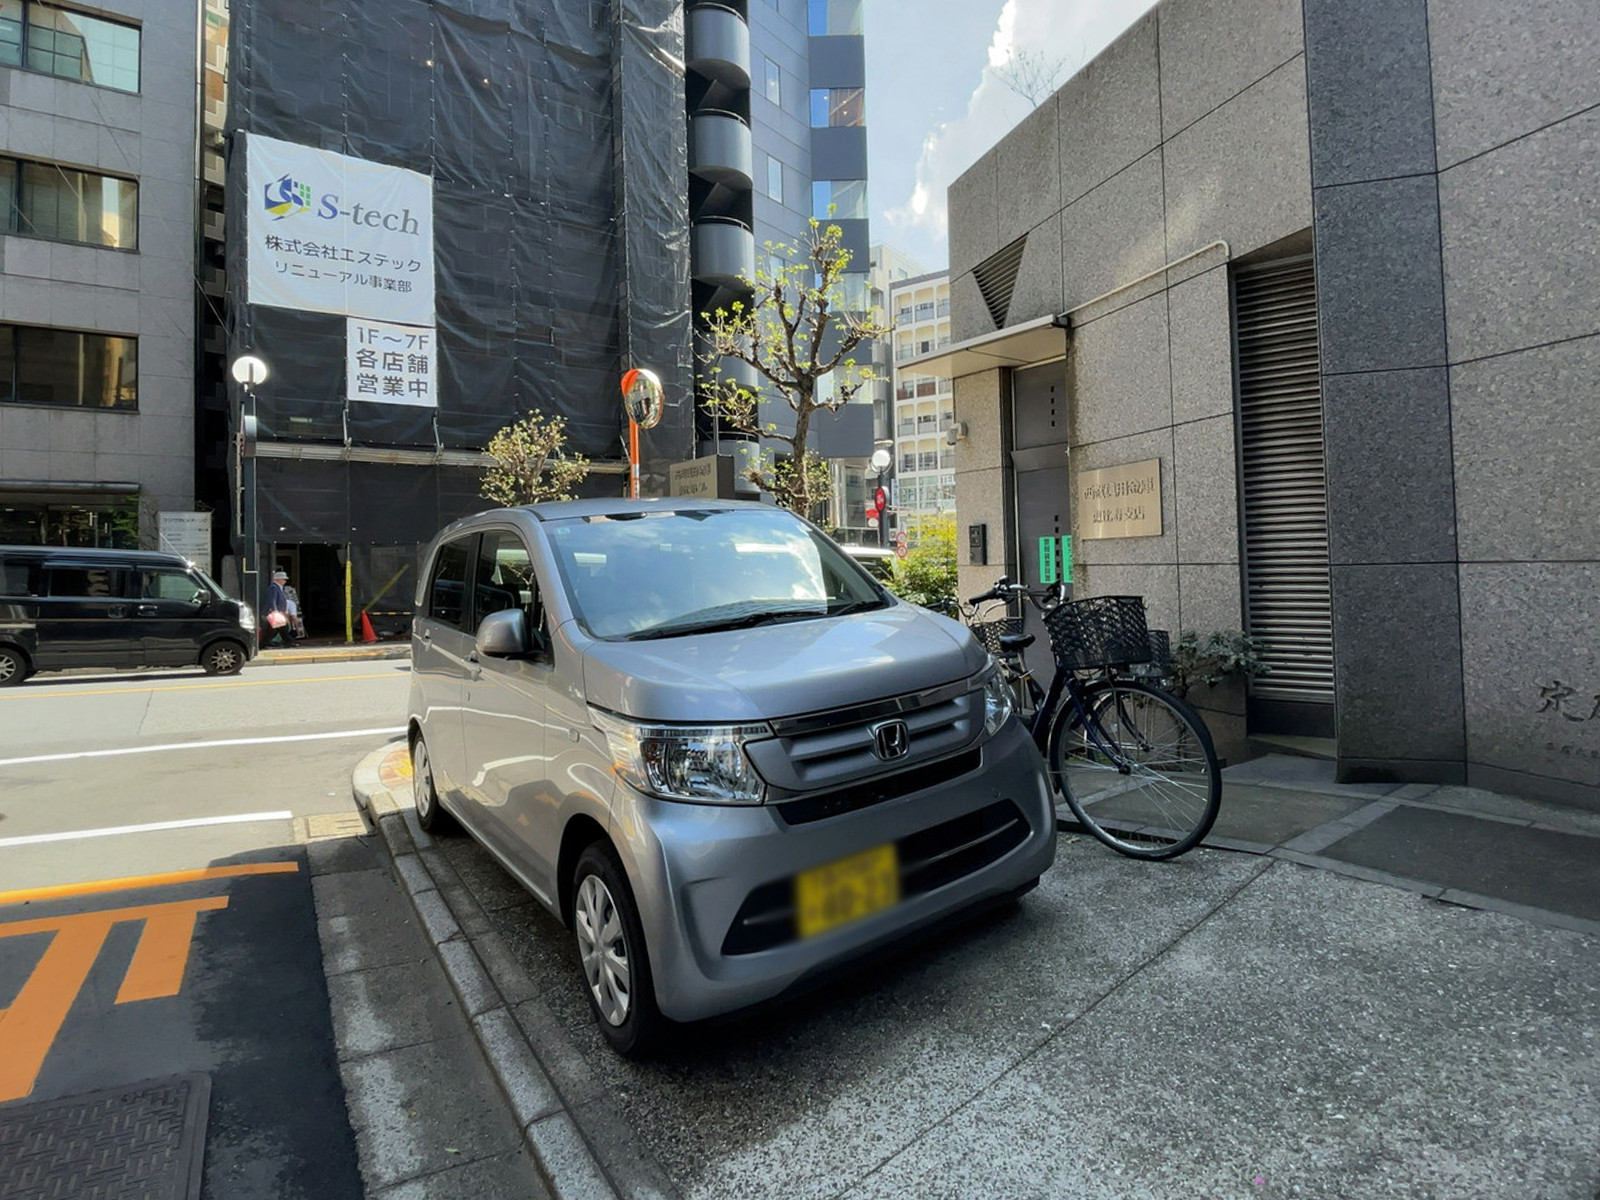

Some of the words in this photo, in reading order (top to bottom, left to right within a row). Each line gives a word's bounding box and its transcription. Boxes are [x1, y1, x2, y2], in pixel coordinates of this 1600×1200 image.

[317, 193, 420, 236] S-tech
[265, 234, 421, 273] 株式会社エステック
[275, 261, 412, 293] リニューアル事業部
[356, 349, 429, 375] 各店舗
[356, 373, 429, 398] 営業中
